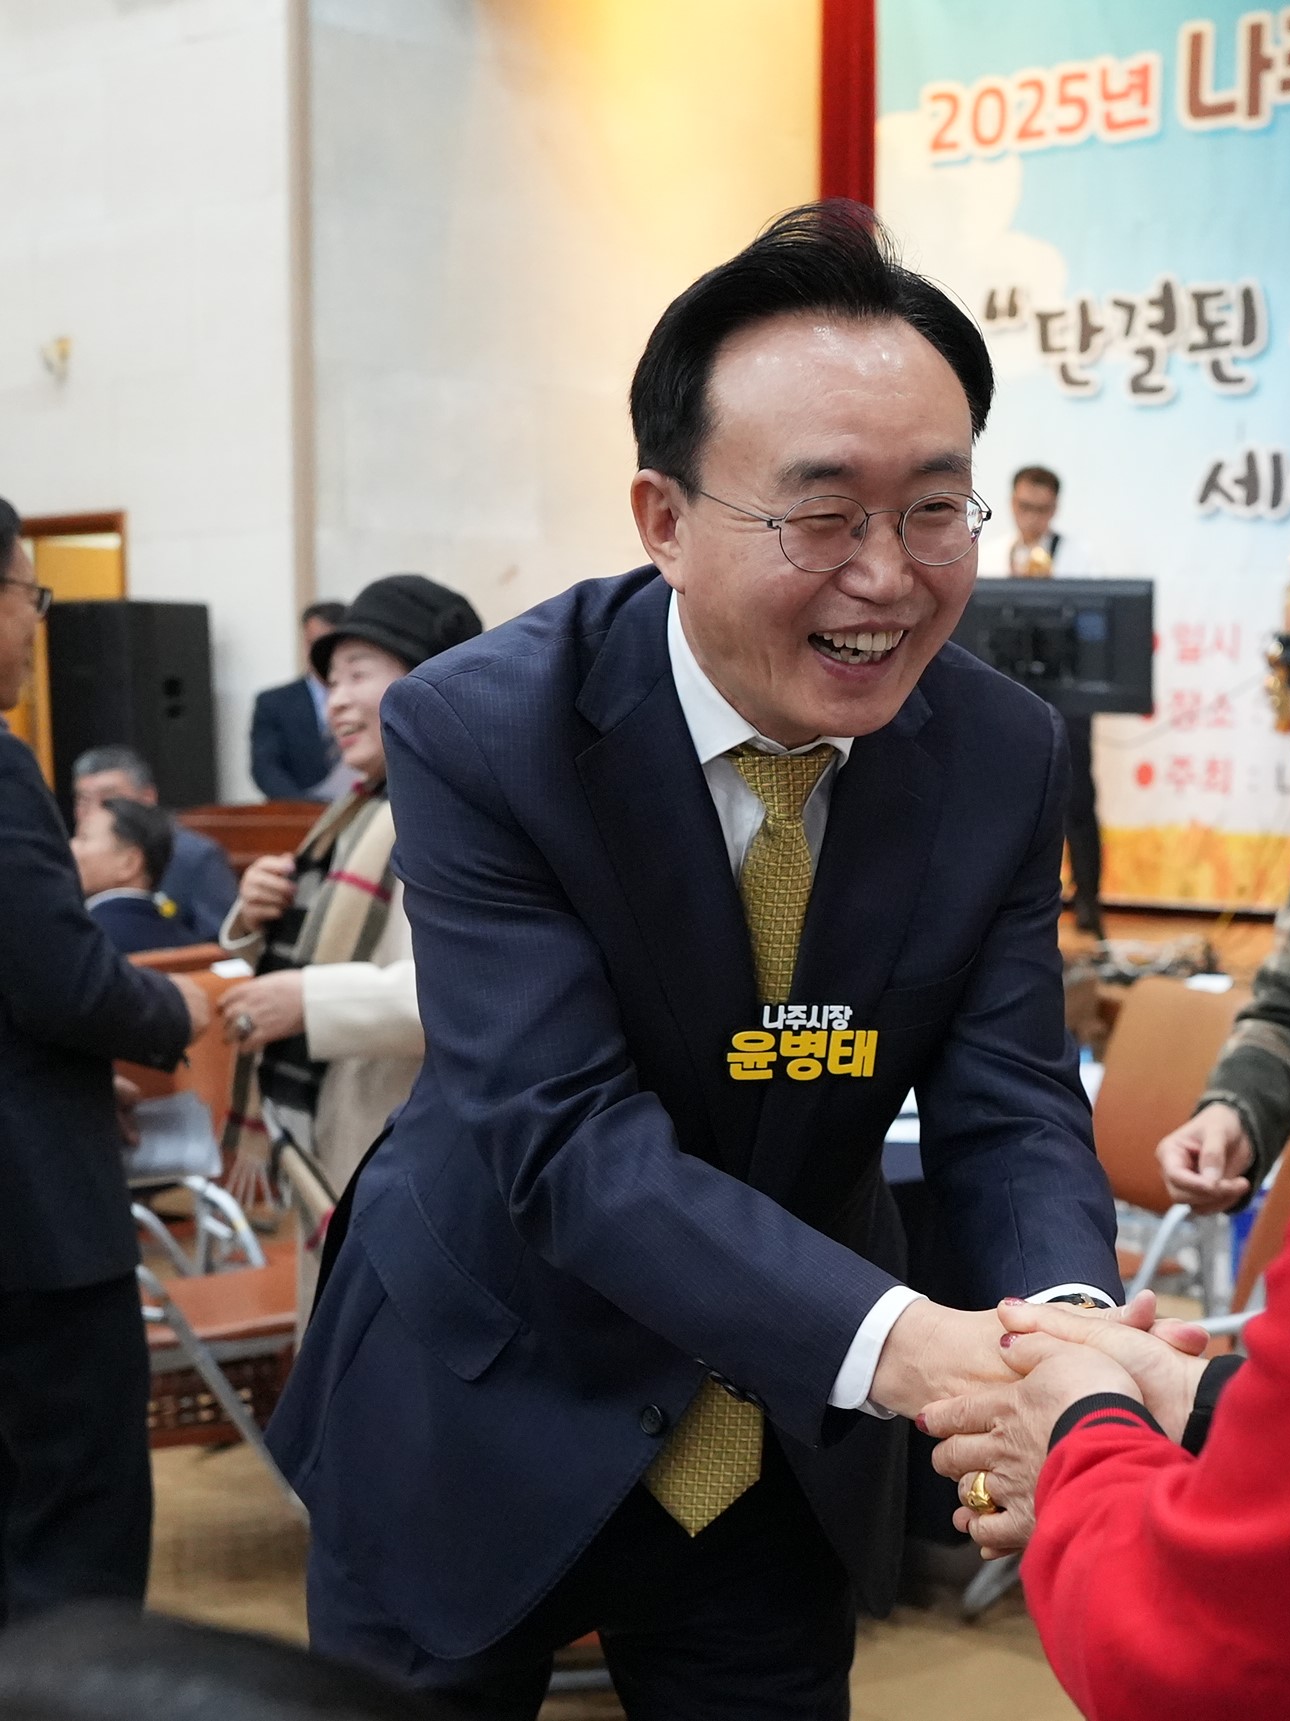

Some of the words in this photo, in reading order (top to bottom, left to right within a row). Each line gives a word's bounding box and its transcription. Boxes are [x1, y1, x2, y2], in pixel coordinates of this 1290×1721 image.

[927, 62, 1152, 153] 2025년
[762, 1004, 853, 1031] 나주시장
[726, 1029, 879, 1082] 윤병태
